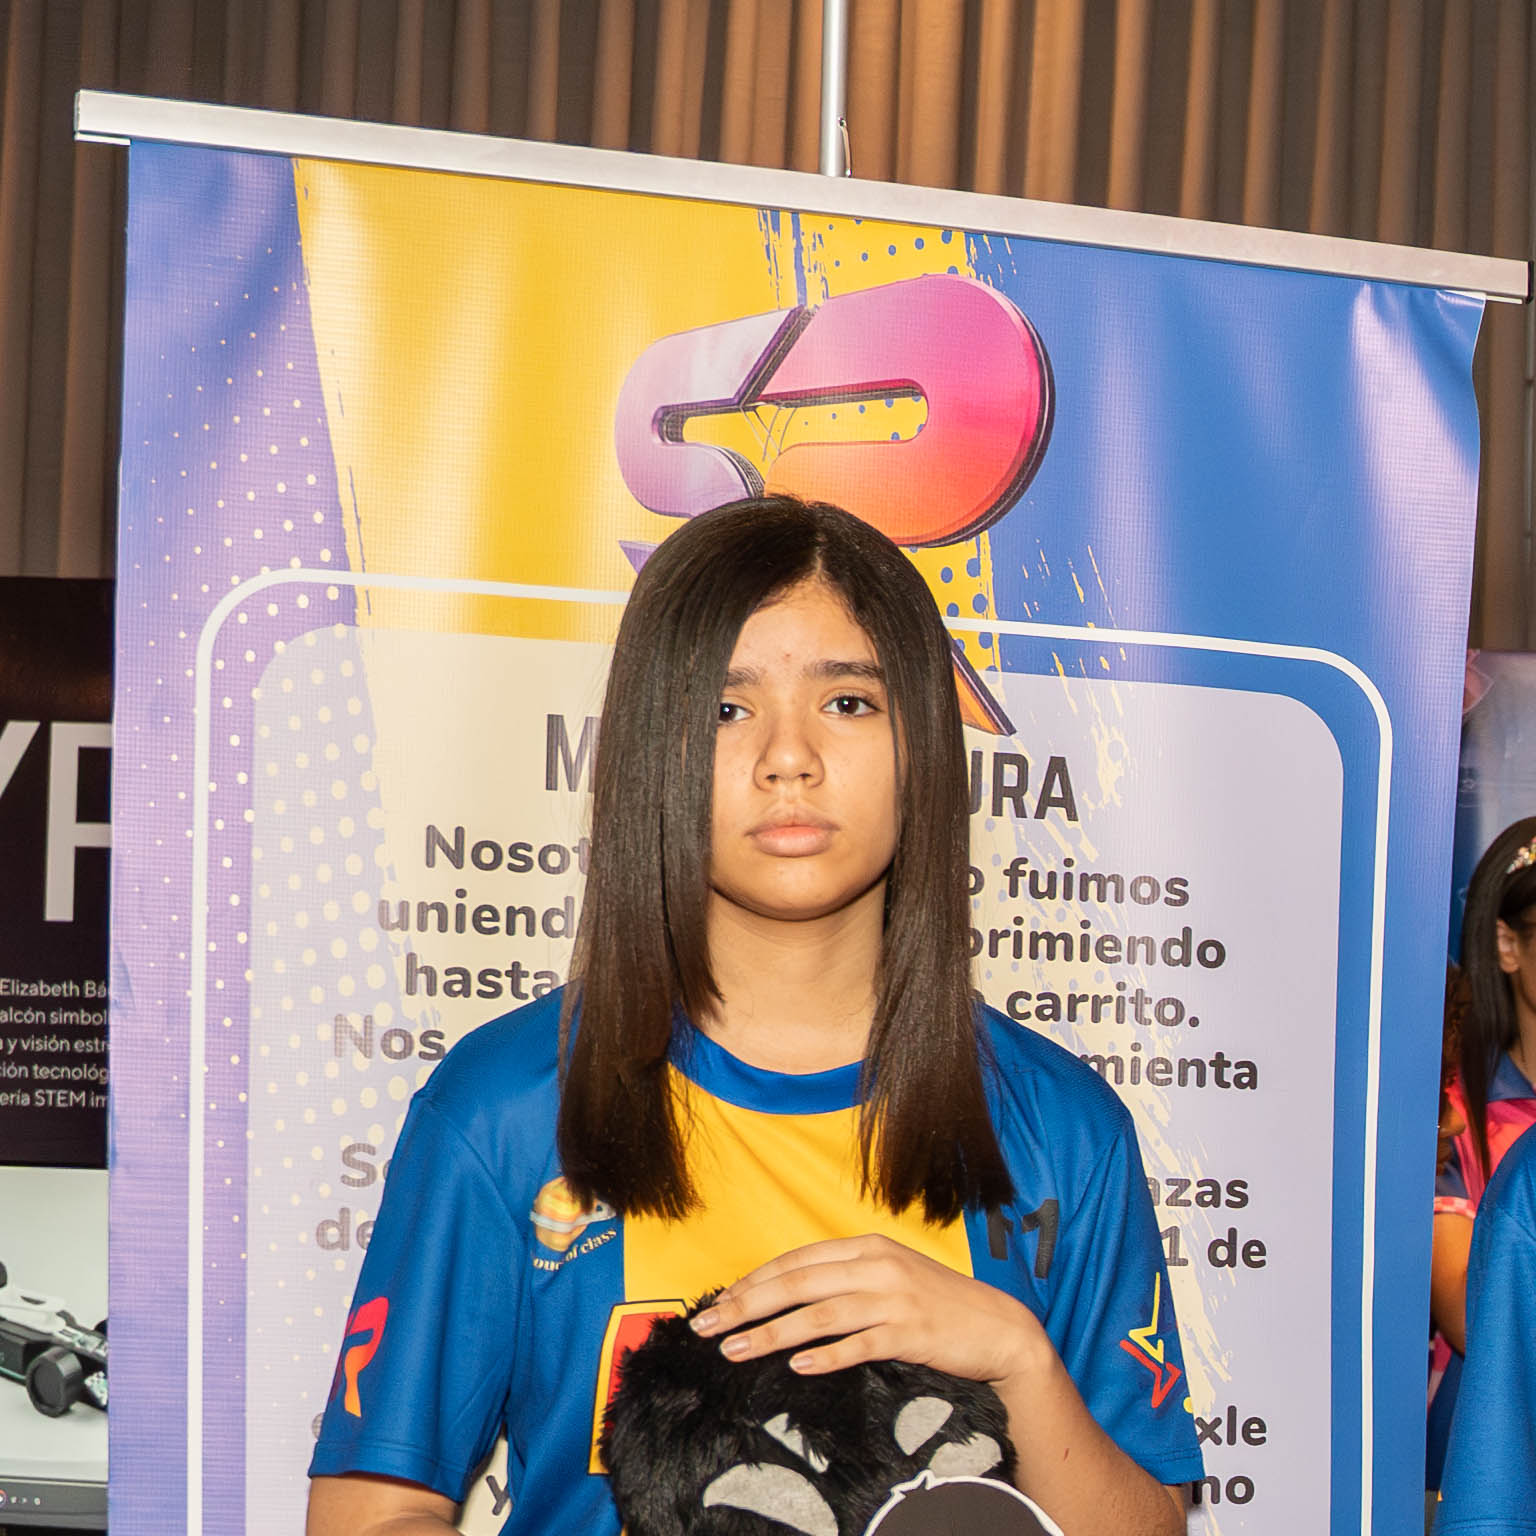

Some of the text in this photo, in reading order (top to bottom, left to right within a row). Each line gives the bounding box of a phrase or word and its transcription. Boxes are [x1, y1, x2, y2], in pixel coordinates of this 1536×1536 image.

[1003, 857, 1191, 907] fuimos
[0, 977, 81, 998] Elizabeth
[1005, 981, 1200, 1028] carrito.
[20, 1034, 71, 1052] visión
[333, 1012, 447, 1062] Nos
[0, 1061, 29, 1079] ión
[34, 1089, 86, 1107] STEM
[580, 1228, 617, 1254] class
[1207, 1227, 1268, 1269] de
